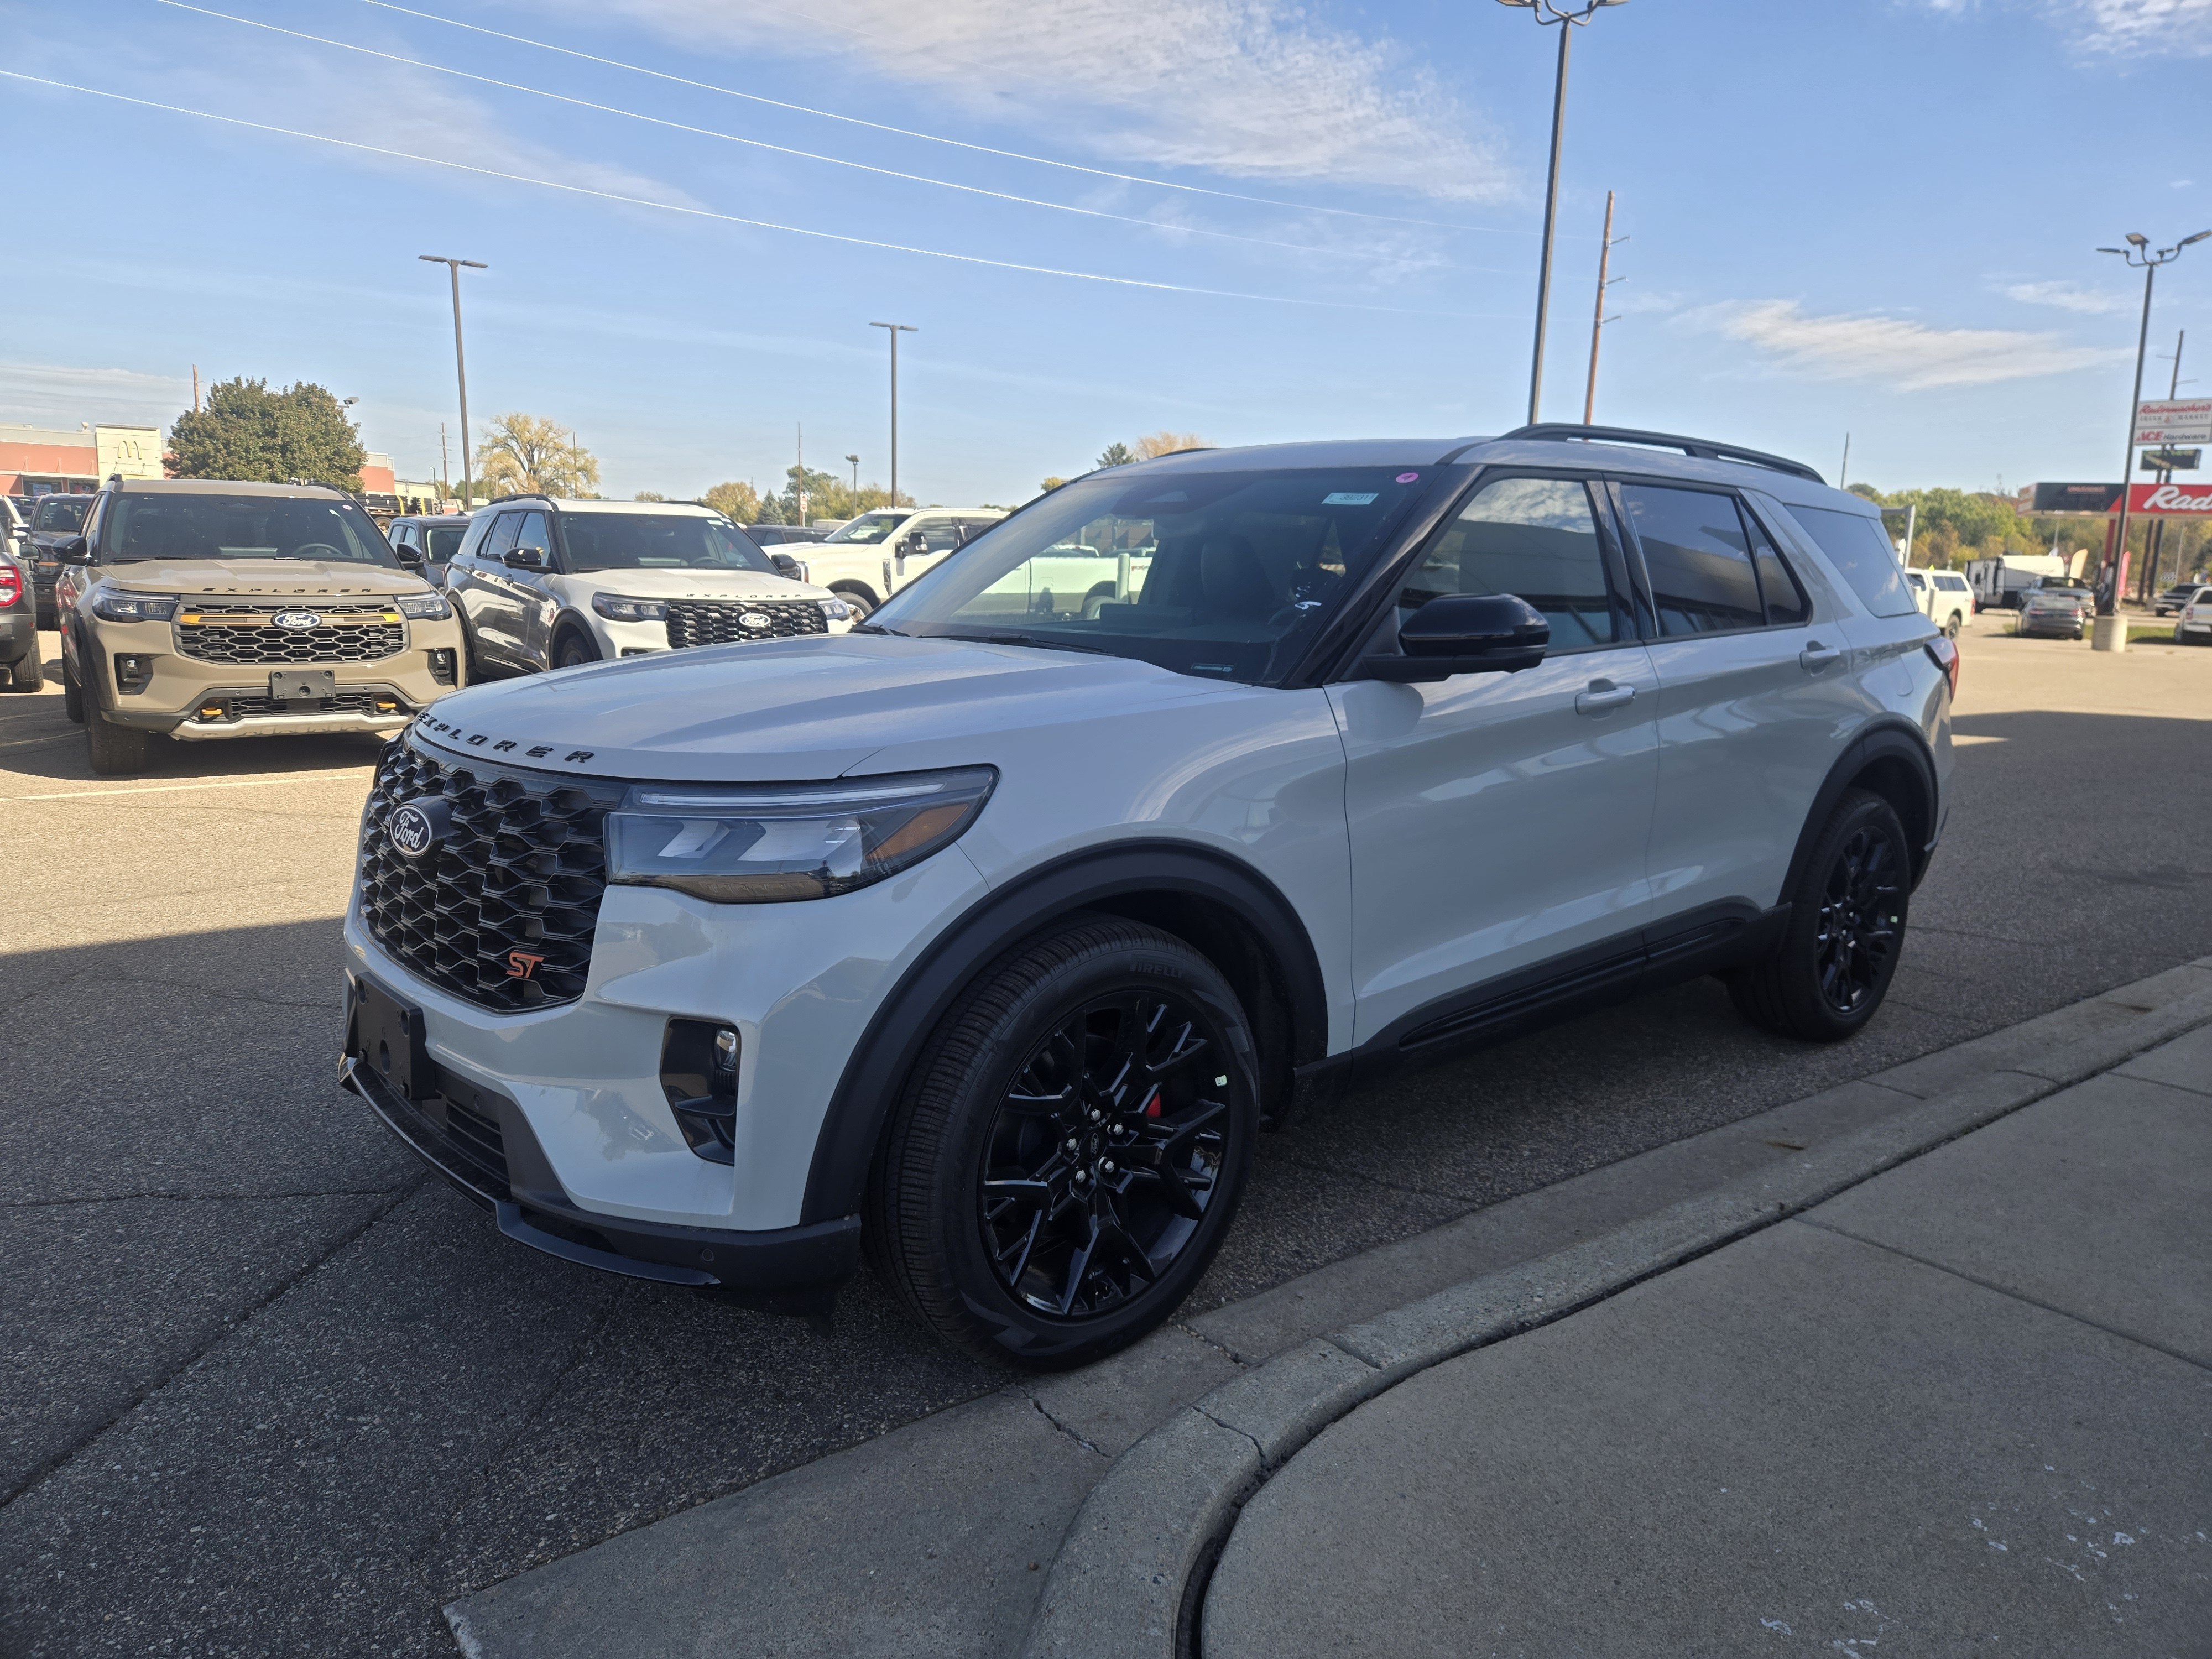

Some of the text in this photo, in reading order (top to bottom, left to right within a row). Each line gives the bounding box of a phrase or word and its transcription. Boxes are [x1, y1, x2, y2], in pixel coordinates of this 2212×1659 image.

[2136, 430, 2163, 441] ACE
[282, 614, 313, 626] Ford
[744, 615, 766, 626] Ford
[416, 711, 594, 763] EXPLORER
[394, 811, 424, 849] Ford
[506, 950, 544, 978] ST
[1129, 958, 1183, 978] PIRELLI
